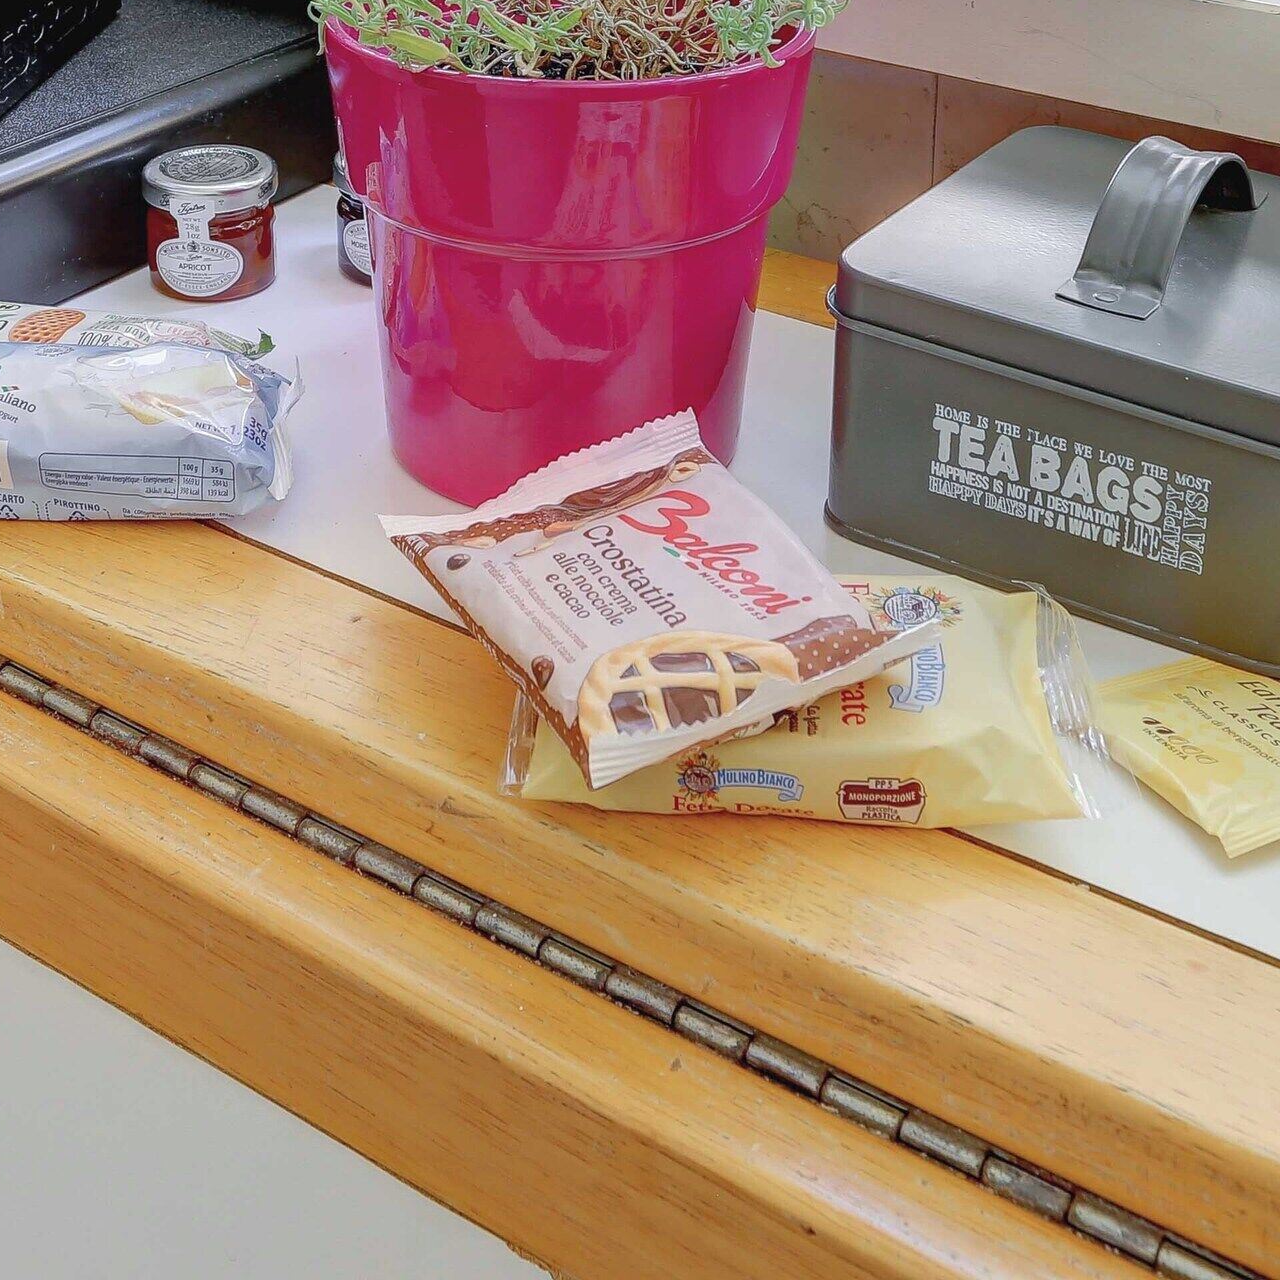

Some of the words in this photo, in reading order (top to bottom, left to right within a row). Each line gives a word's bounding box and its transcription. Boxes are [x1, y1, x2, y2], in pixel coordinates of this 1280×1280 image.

[185, 223, 200, 232] 28g
[187, 231, 200, 239] 1oz
[178, 263, 212, 272] APRICOT
[934, 403, 972, 425] HOME
[976, 414, 989, 429] IS
[995, 420, 1021, 439] THE
[1074, 442, 1093, 459] WE
[1099, 449, 1135, 471] LOVE
[1141, 461, 1168, 481] THE
[1175, 471, 1212, 493] MOST
[932, 416, 1020, 482] TEA
[1029, 443, 1163, 523] BAGS
[53, 498, 101, 511] PIROTTINO
[928, 475, 984, 506] HAPPY
[984, 492, 1027, 519] DAYS
[931, 460, 990, 490] HAPPINESS
[993, 478, 1003, 494] IS
[1007, 482, 1031, 502] NOT
[1034, 491, 1043, 507] A
[1047, 495, 1120, 531] DESTINATION
[1027, 504, 1055, 528] IT'S
[1056, 514, 1066, 532] A
[1069, 516, 1101, 542] WAY
[1103, 528, 1121, 548] OF
[1122, 517, 1162, 562] LIFE
[1160, 483, 1185, 569] HAPPY
[1178, 489, 1209, 575] DAYS
[617, 489, 813, 615] Balconi
[545, 573, 560, 584] e
[553, 552, 578, 576] alle
[571, 575, 624, 627] nocciole
[577, 551, 603, 576] con
[598, 572, 639, 615] crema
[583, 524, 687, 629] Crostatina
[698, 572, 739, 600] MILANO
[552, 584, 591, 619] cacao
[1211, 718, 1224, 730] di
[848, 791, 916, 803] MONOPORZIONE
[874, 780, 887, 789] PP
[862, 812, 902, 821] PLASTICA
[866, 806, 899, 814] Raccolta
